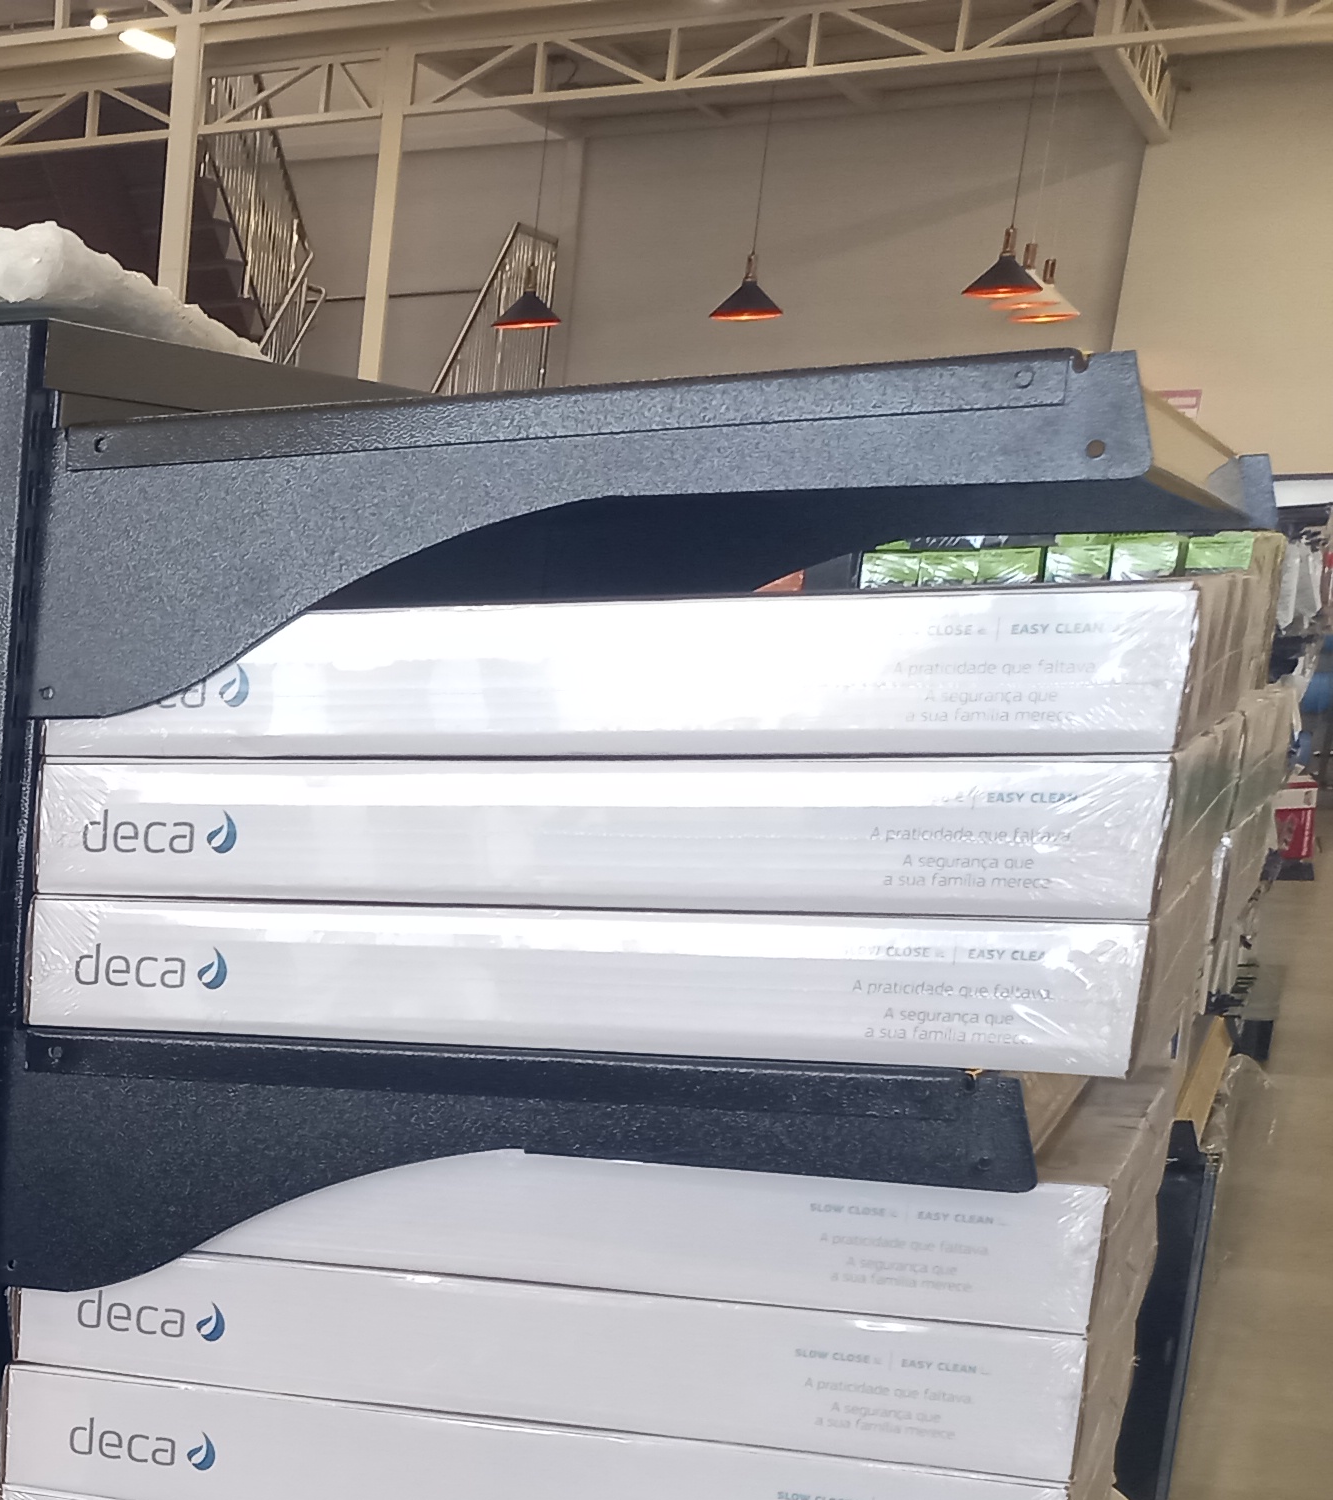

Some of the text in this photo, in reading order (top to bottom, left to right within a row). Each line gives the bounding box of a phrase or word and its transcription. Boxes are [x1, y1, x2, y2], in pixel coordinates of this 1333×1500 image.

[83, 809, 195, 854] deca
[903, 854, 1034, 871] A segurança que
[75, 942, 186, 988] deca
[864, 1027, 874, 1038] a
[880, 1028, 906, 1039] sua
[884, 1007, 1014, 1026] A segurança que
[77, 1290, 185, 1338] deca
[795, 1348, 976, 1374] SLOW CLOSE EASY CLEAN
[69, 1417, 176, 1466] deca
